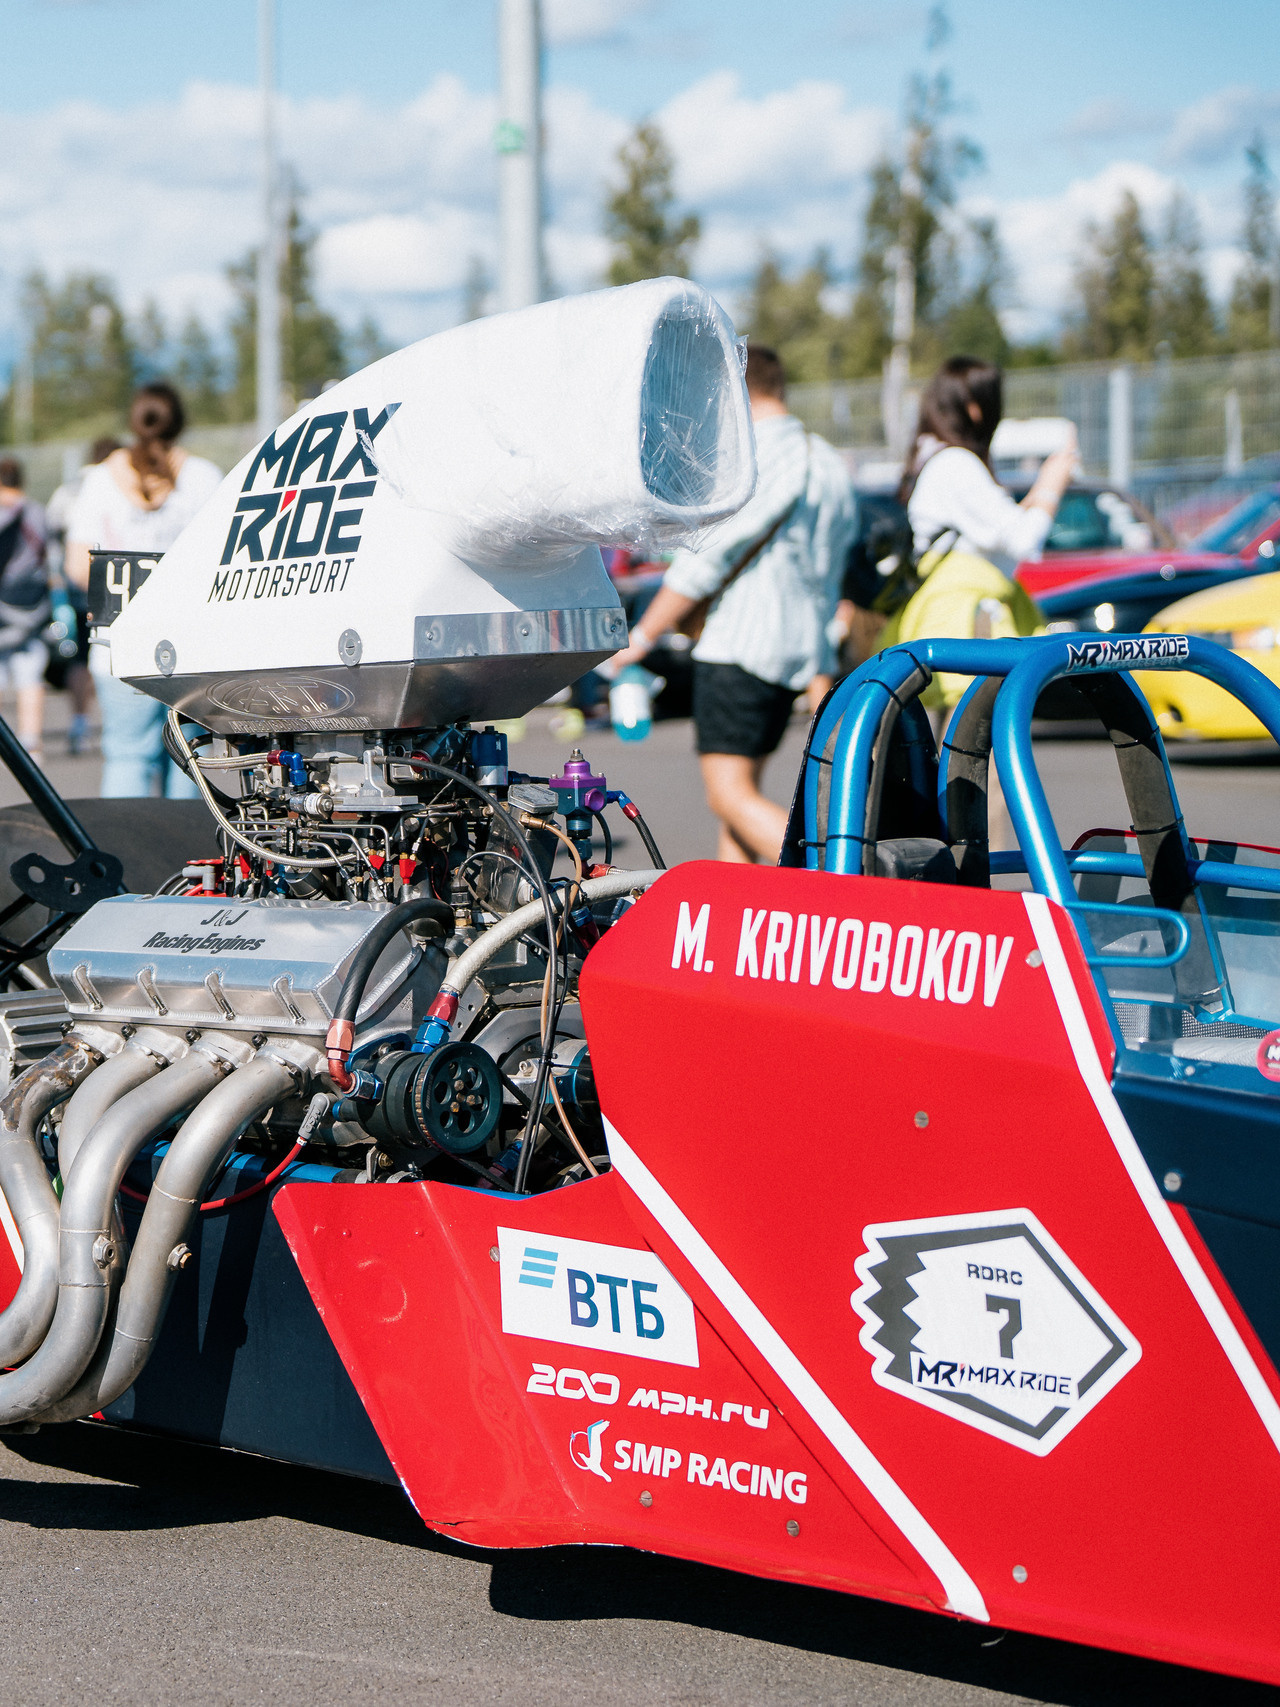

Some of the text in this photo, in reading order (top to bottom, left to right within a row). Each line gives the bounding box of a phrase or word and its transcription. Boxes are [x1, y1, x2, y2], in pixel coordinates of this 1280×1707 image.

[241, 402, 402, 493] MAX
[207, 557, 355, 603] MOTORSPORT
[142, 931, 266, 955] Racing Engines
[200, 909, 249, 927] J&J
[670, 900, 1014, 1007] M. KRIVOBOKOV
[967, 1262, 1023, 1286] RDRC
[566, 1268, 665, 1340] ВТБ
[985, 1293, 1023, 1360] 7
[526, 1362, 620, 1405] 200
[613, 1439, 808, 1504] SMP RACING
